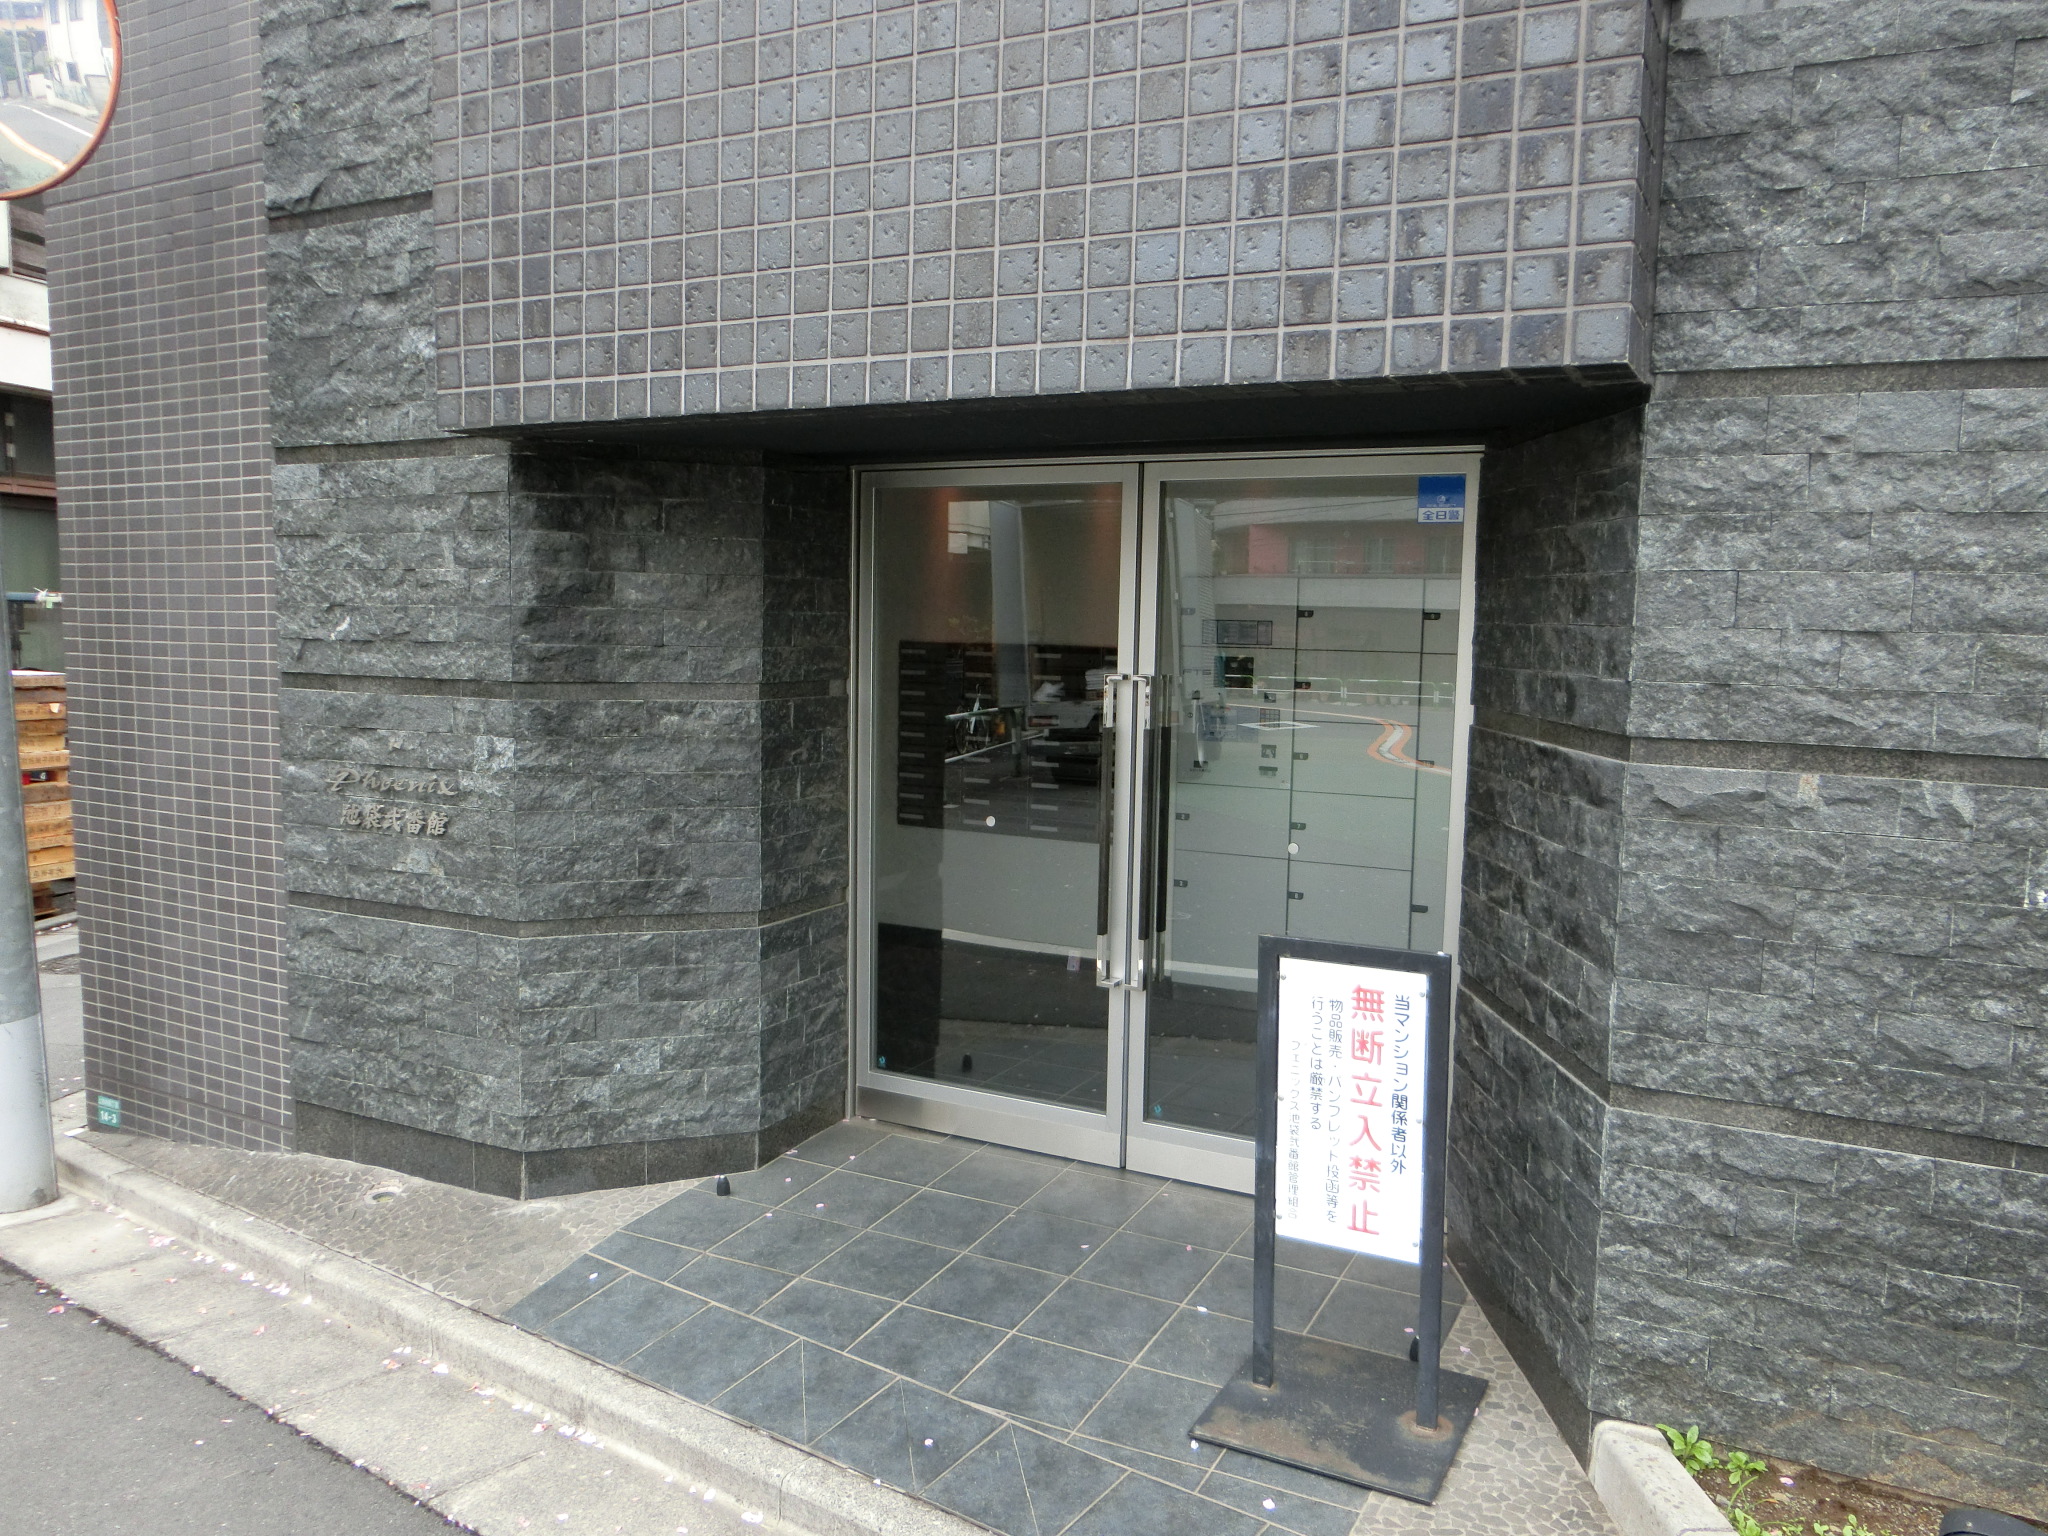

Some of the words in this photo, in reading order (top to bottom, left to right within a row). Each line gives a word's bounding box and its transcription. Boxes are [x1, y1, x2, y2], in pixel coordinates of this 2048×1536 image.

[324, 767, 459, 796] Phoenix
[340, 803, 449, 836] 池袋弐番館
[1309, 995, 1325, 1131] 行うことは厳禁する
[1347, 984, 1386, 1236] 無断立入禁止
[1390, 993, 1411, 1175] 当マンション関係者以外
